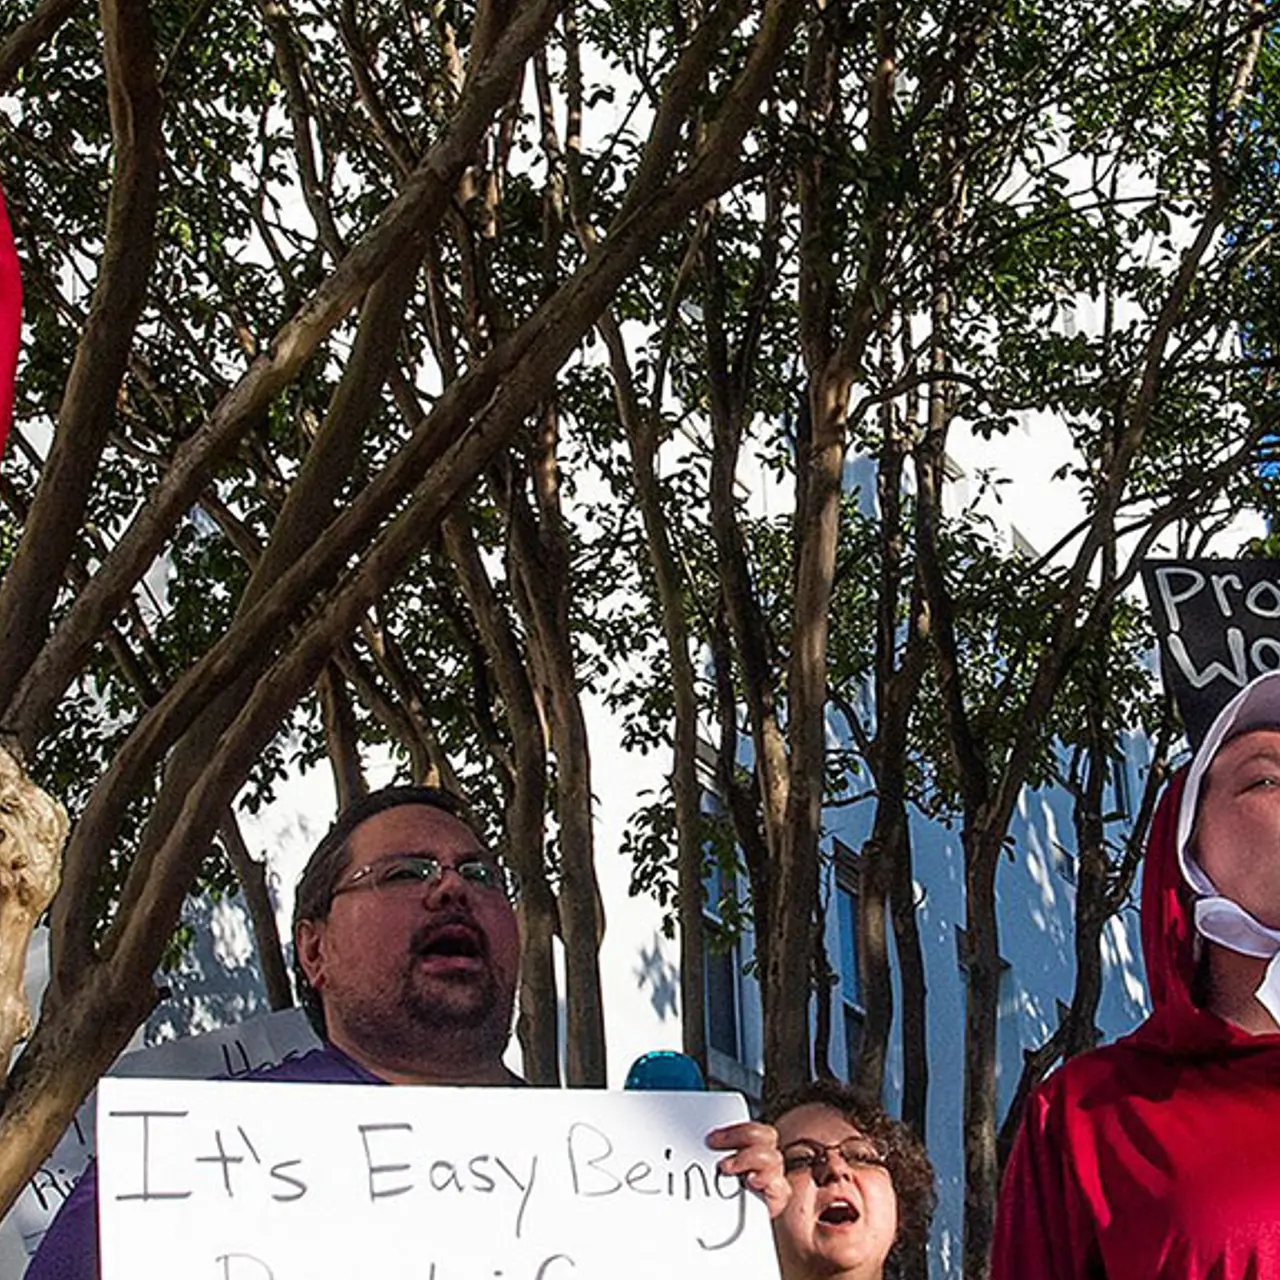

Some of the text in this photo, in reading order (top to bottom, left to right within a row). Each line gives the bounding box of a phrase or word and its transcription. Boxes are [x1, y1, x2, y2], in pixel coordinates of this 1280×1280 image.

[108, 1111, 308, 1203] It's
[358, 1122, 538, 1238] Easy
[566, 1122, 748, 1251] Being
